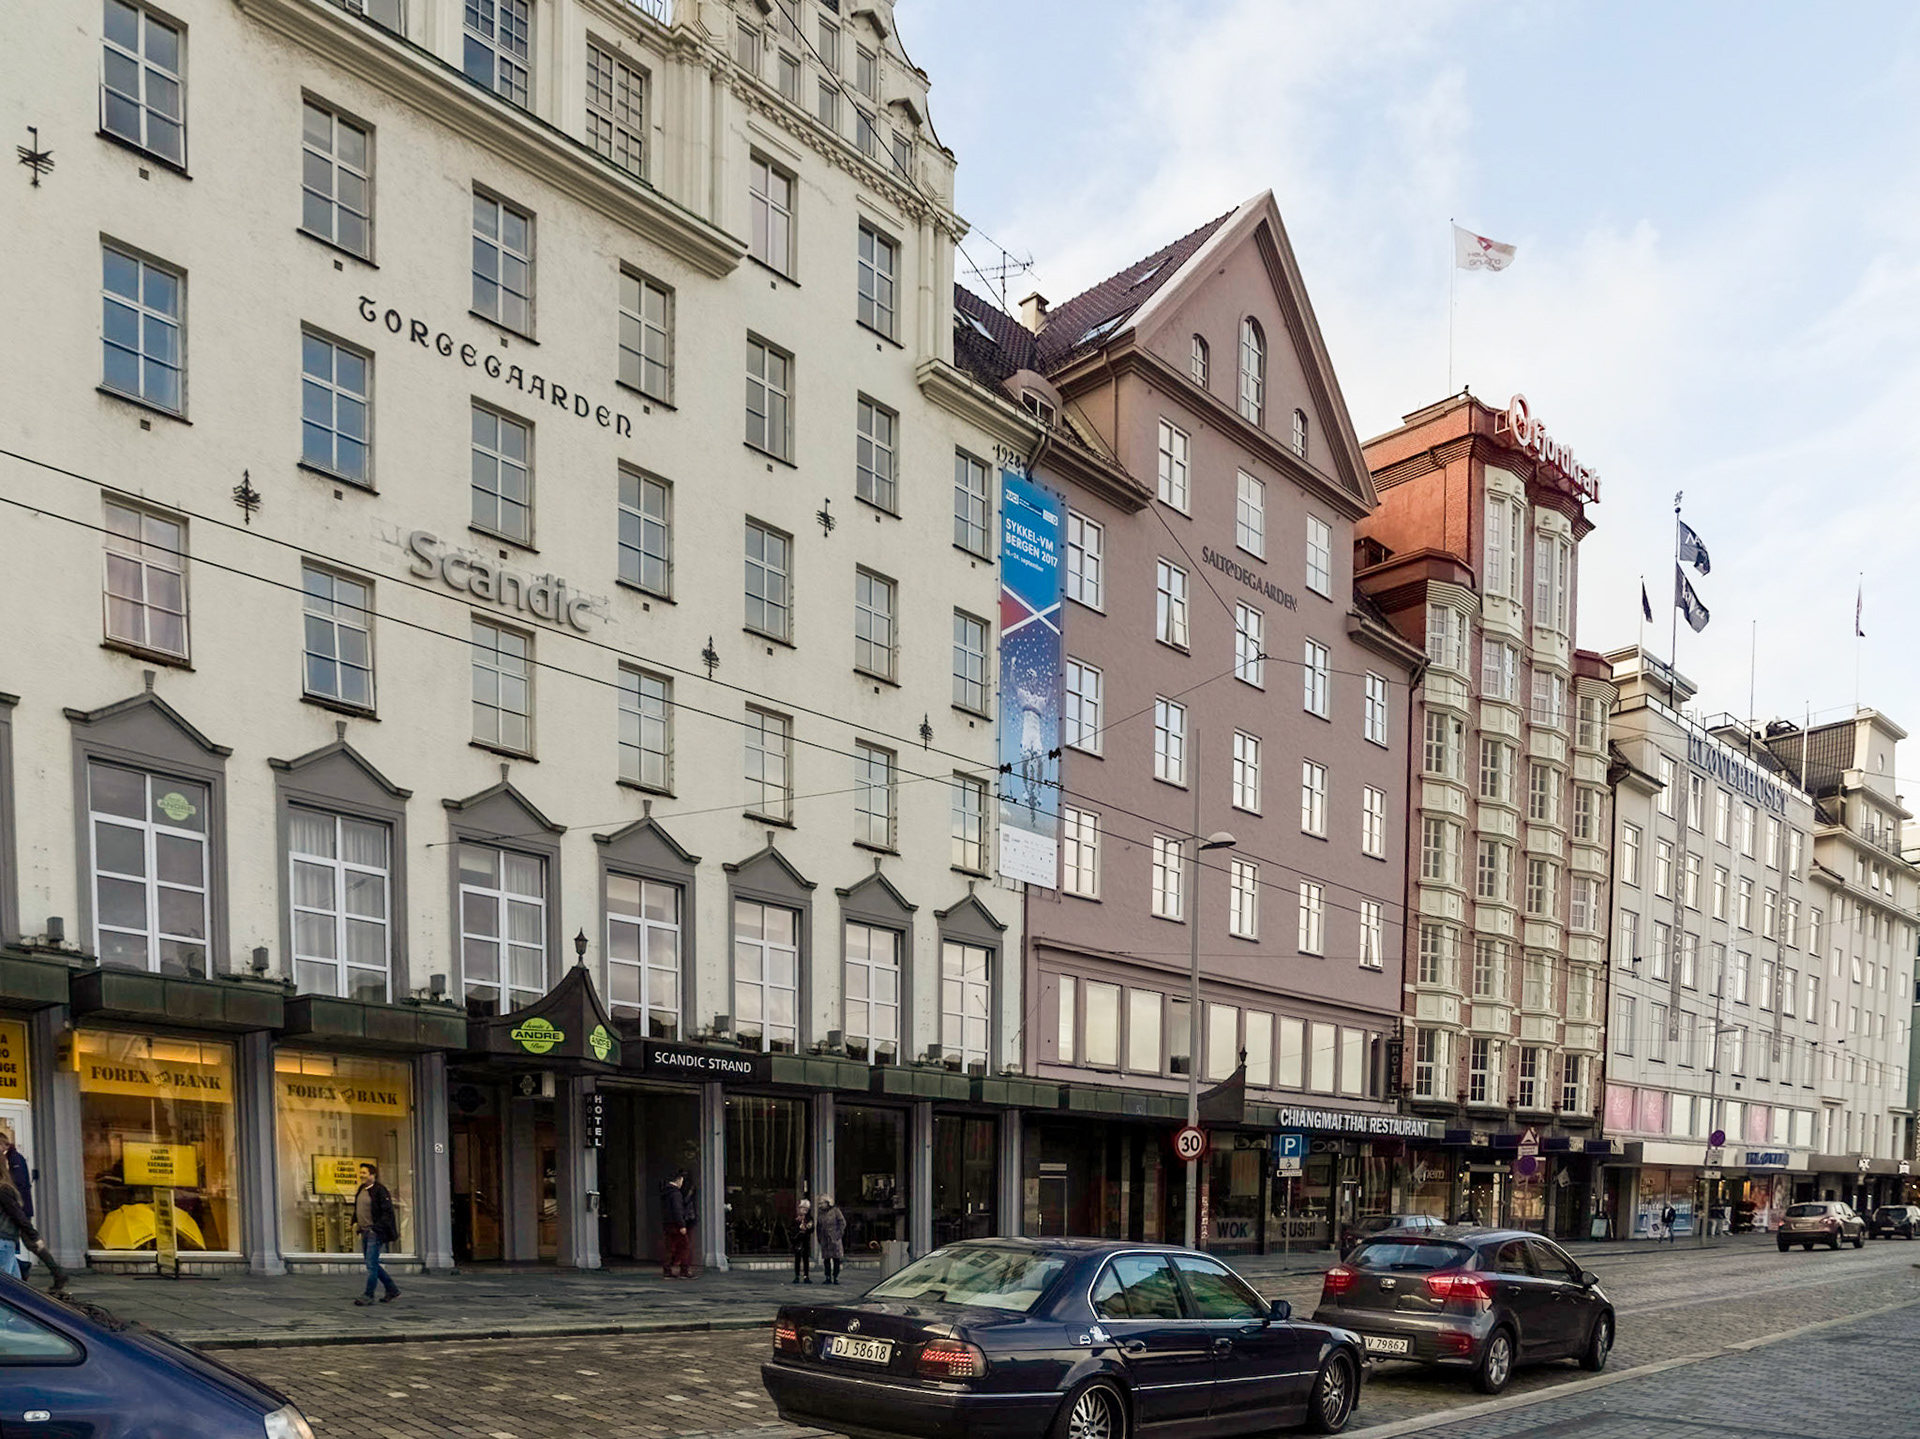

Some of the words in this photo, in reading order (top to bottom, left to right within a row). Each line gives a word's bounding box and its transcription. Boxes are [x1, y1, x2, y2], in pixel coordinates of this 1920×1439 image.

[359, 296, 631, 438] TORGEGAARDEN
[995, 443, 1021, 469] 1928
[1532, 418, 1601, 503] fjordkraft
[1005, 518, 1053, 552] SYKKEL-VM
[1005, 531, 1040, 559] BERGEN
[1041, 550, 1058, 567] 2017
[409, 530, 592, 632] Scandic
[1688, 734, 1789, 816] KLØVERHUSET
[515, 1031, 560, 1040] ANDRE
[654, 1051, 705, 1068] SCANDIC
[708, 1058, 752, 1074] STRAND
[1391, 1046, 1399, 1093] HOTEL
[91, 1066, 150, 1084] FOREX
[174, 1073, 222, 1090] BANK
[287, 1084, 337, 1100] FOREX
[357, 1090, 398, 1105] BANK
[594, 1095, 602, 1147] HOTEL
[1280, 1109, 1343, 1131] CHIANGMAI
[1344, 1113, 1367, 1132] THAI
[1369, 1117, 1429, 1137] RESTAURANT
[1181, 1135, 1200, 1152] 30
[1284, 1138, 1297, 1155] P
[1217, 1222, 1249, 1239] WOK
[1281, 1221, 1316, 1238] SUSHI
[835, 1339, 849, 1355] DJ
[852, 1341, 888, 1361] 58618
[1376, 1337, 1406, 1351] 79862
